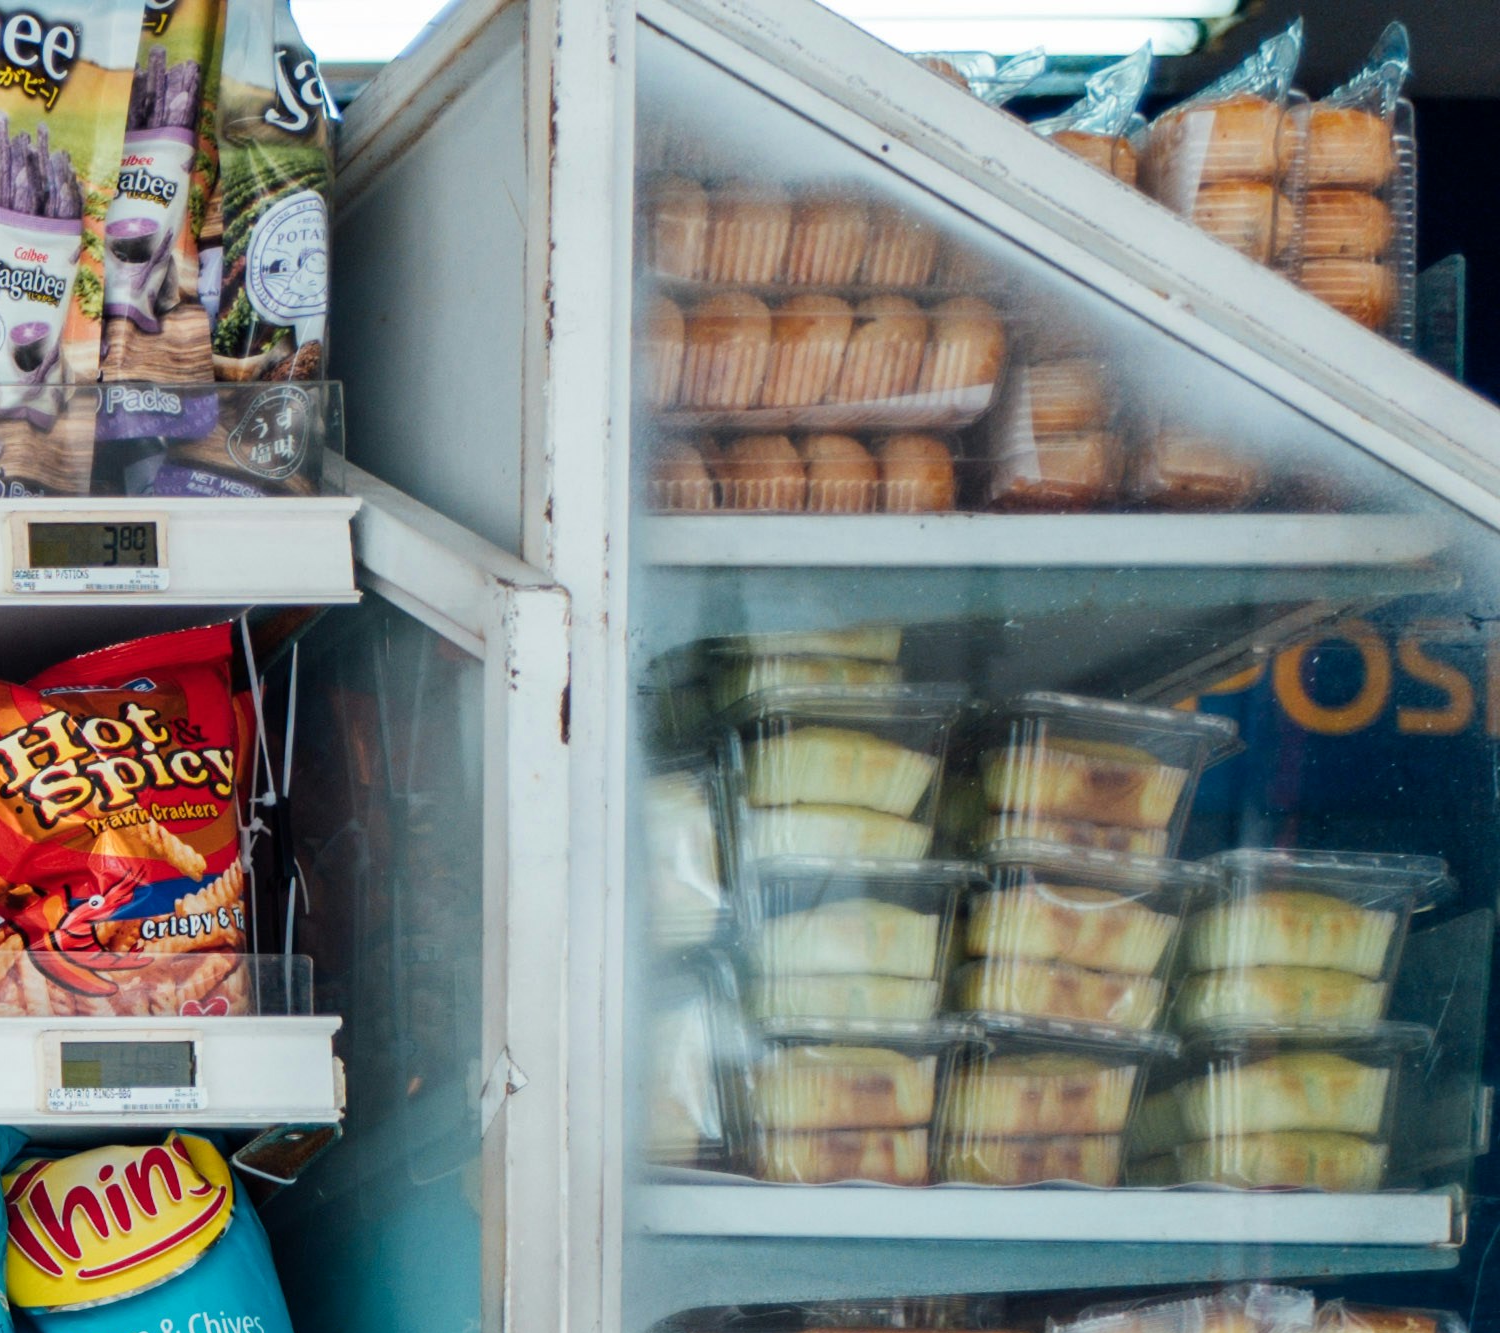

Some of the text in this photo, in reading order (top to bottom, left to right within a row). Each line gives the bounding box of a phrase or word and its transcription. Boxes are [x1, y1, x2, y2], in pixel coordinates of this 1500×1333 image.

[13, 245, 49, 264] Calbee
[106, 387, 181, 416] Packs
[169, 716, 205, 747] &
[31, 745, 235, 823] Spicy
[86, 801, 218, 835] Prawn Crackers
